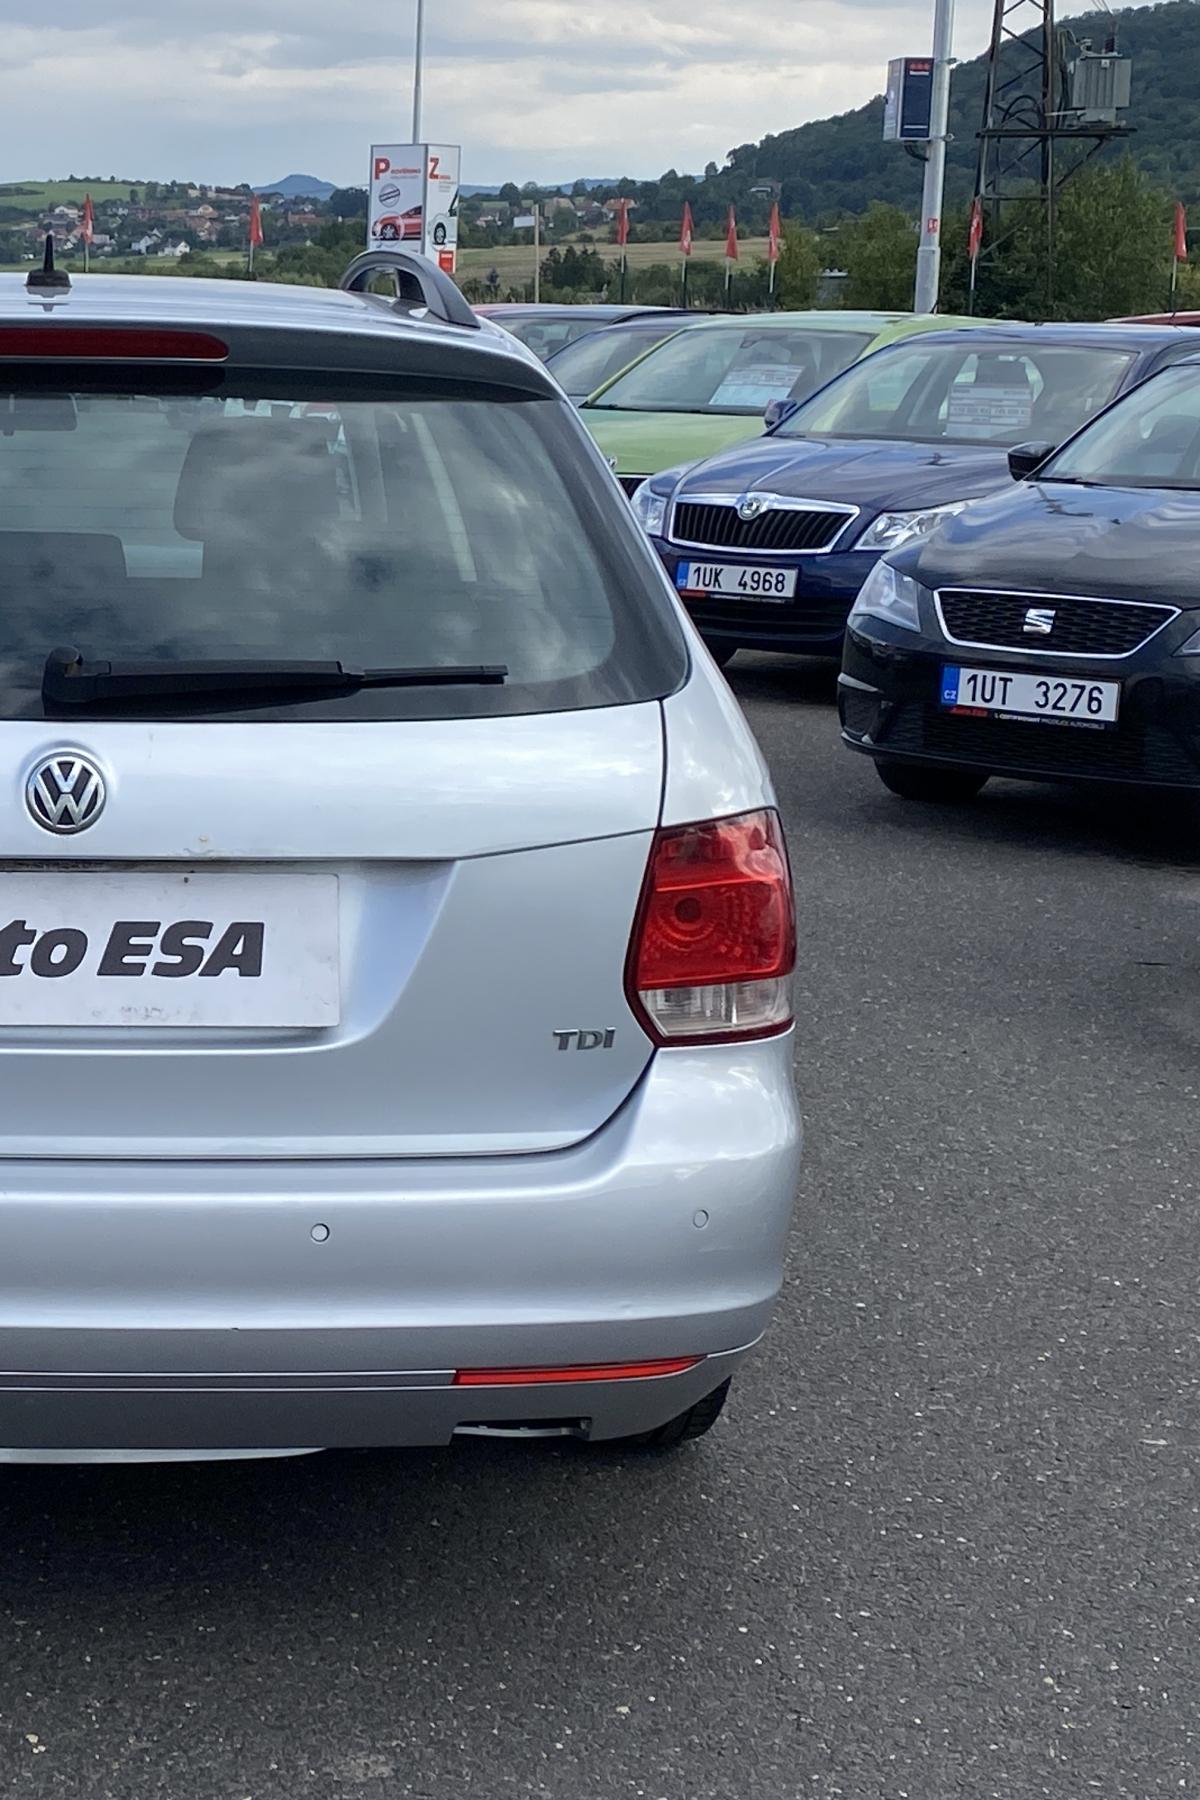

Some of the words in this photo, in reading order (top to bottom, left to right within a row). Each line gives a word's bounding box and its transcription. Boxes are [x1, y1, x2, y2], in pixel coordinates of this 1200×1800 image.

[693, 566, 724, 589] 1UK
[738, 569, 786, 593] 4968
[943, 689, 957, 700] CZ
[966, 673, 1013, 706] 1UT
[1034, 681, 1104, 714] 3276
[95, 919, 265, 977] ESA
[552, 1026, 617, 1051] TDI
